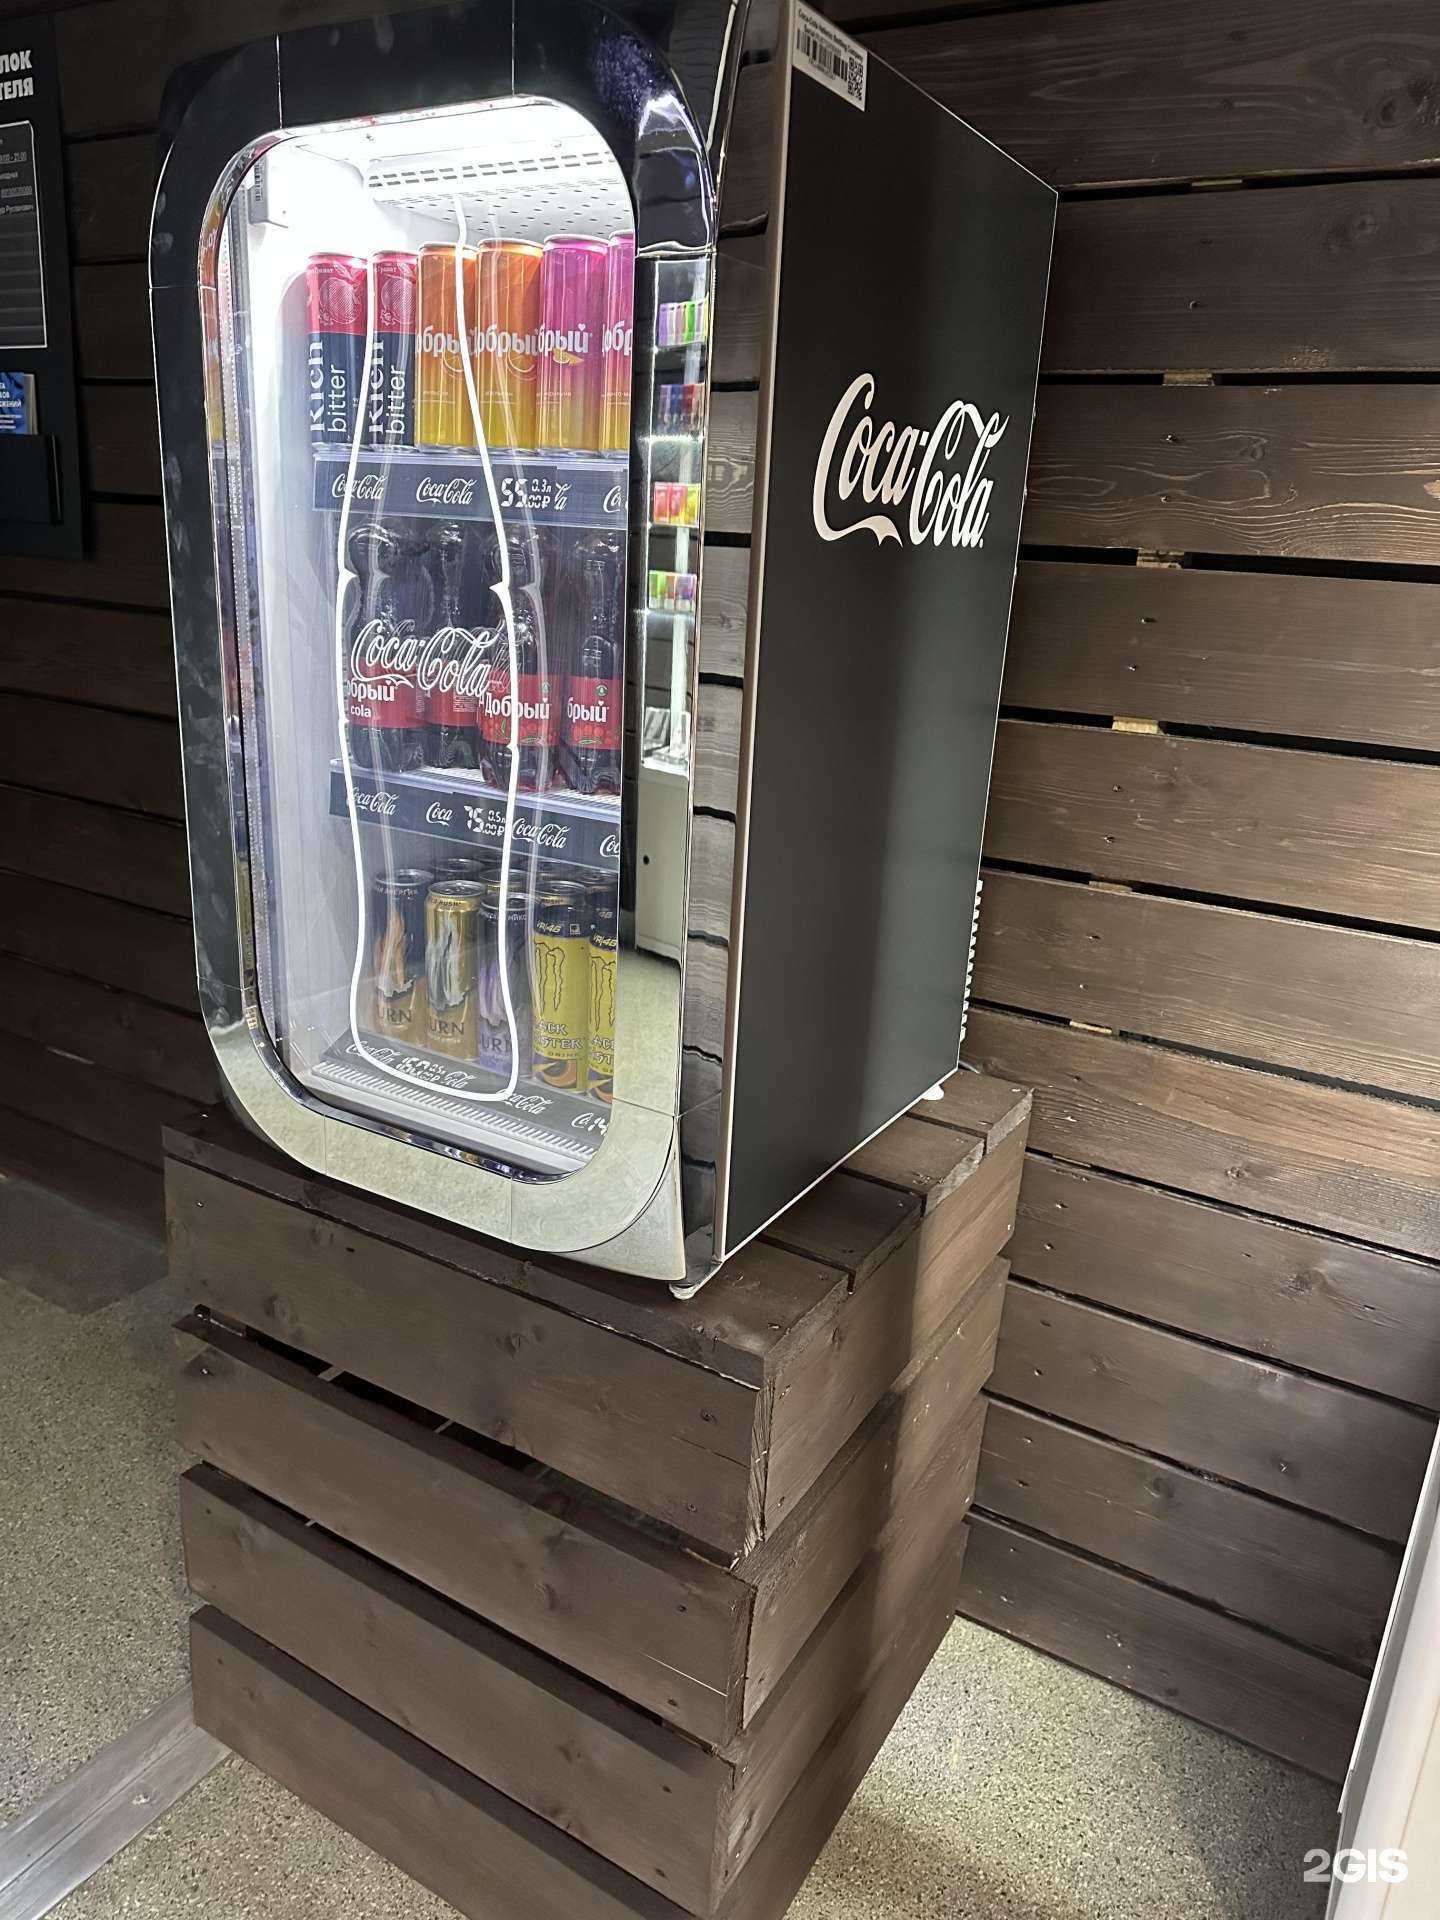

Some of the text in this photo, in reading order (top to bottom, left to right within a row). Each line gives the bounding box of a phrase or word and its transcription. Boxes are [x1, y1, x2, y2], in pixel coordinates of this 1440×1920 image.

[327, 364, 346, 432] bitter
[386, 364, 405, 434] bitter
[812, 373, 1010, 548] Coca-Cola
[416, 476, 477, 505] Coca-Cola
[351, 619, 500, 698] Coca-Cola
[351, 705, 372, 718] cola
[351, 786, 399, 816] oca-Cola
[425, 802, 453, 827] Coca
[511, 817, 571, 849] Coca-Cola
